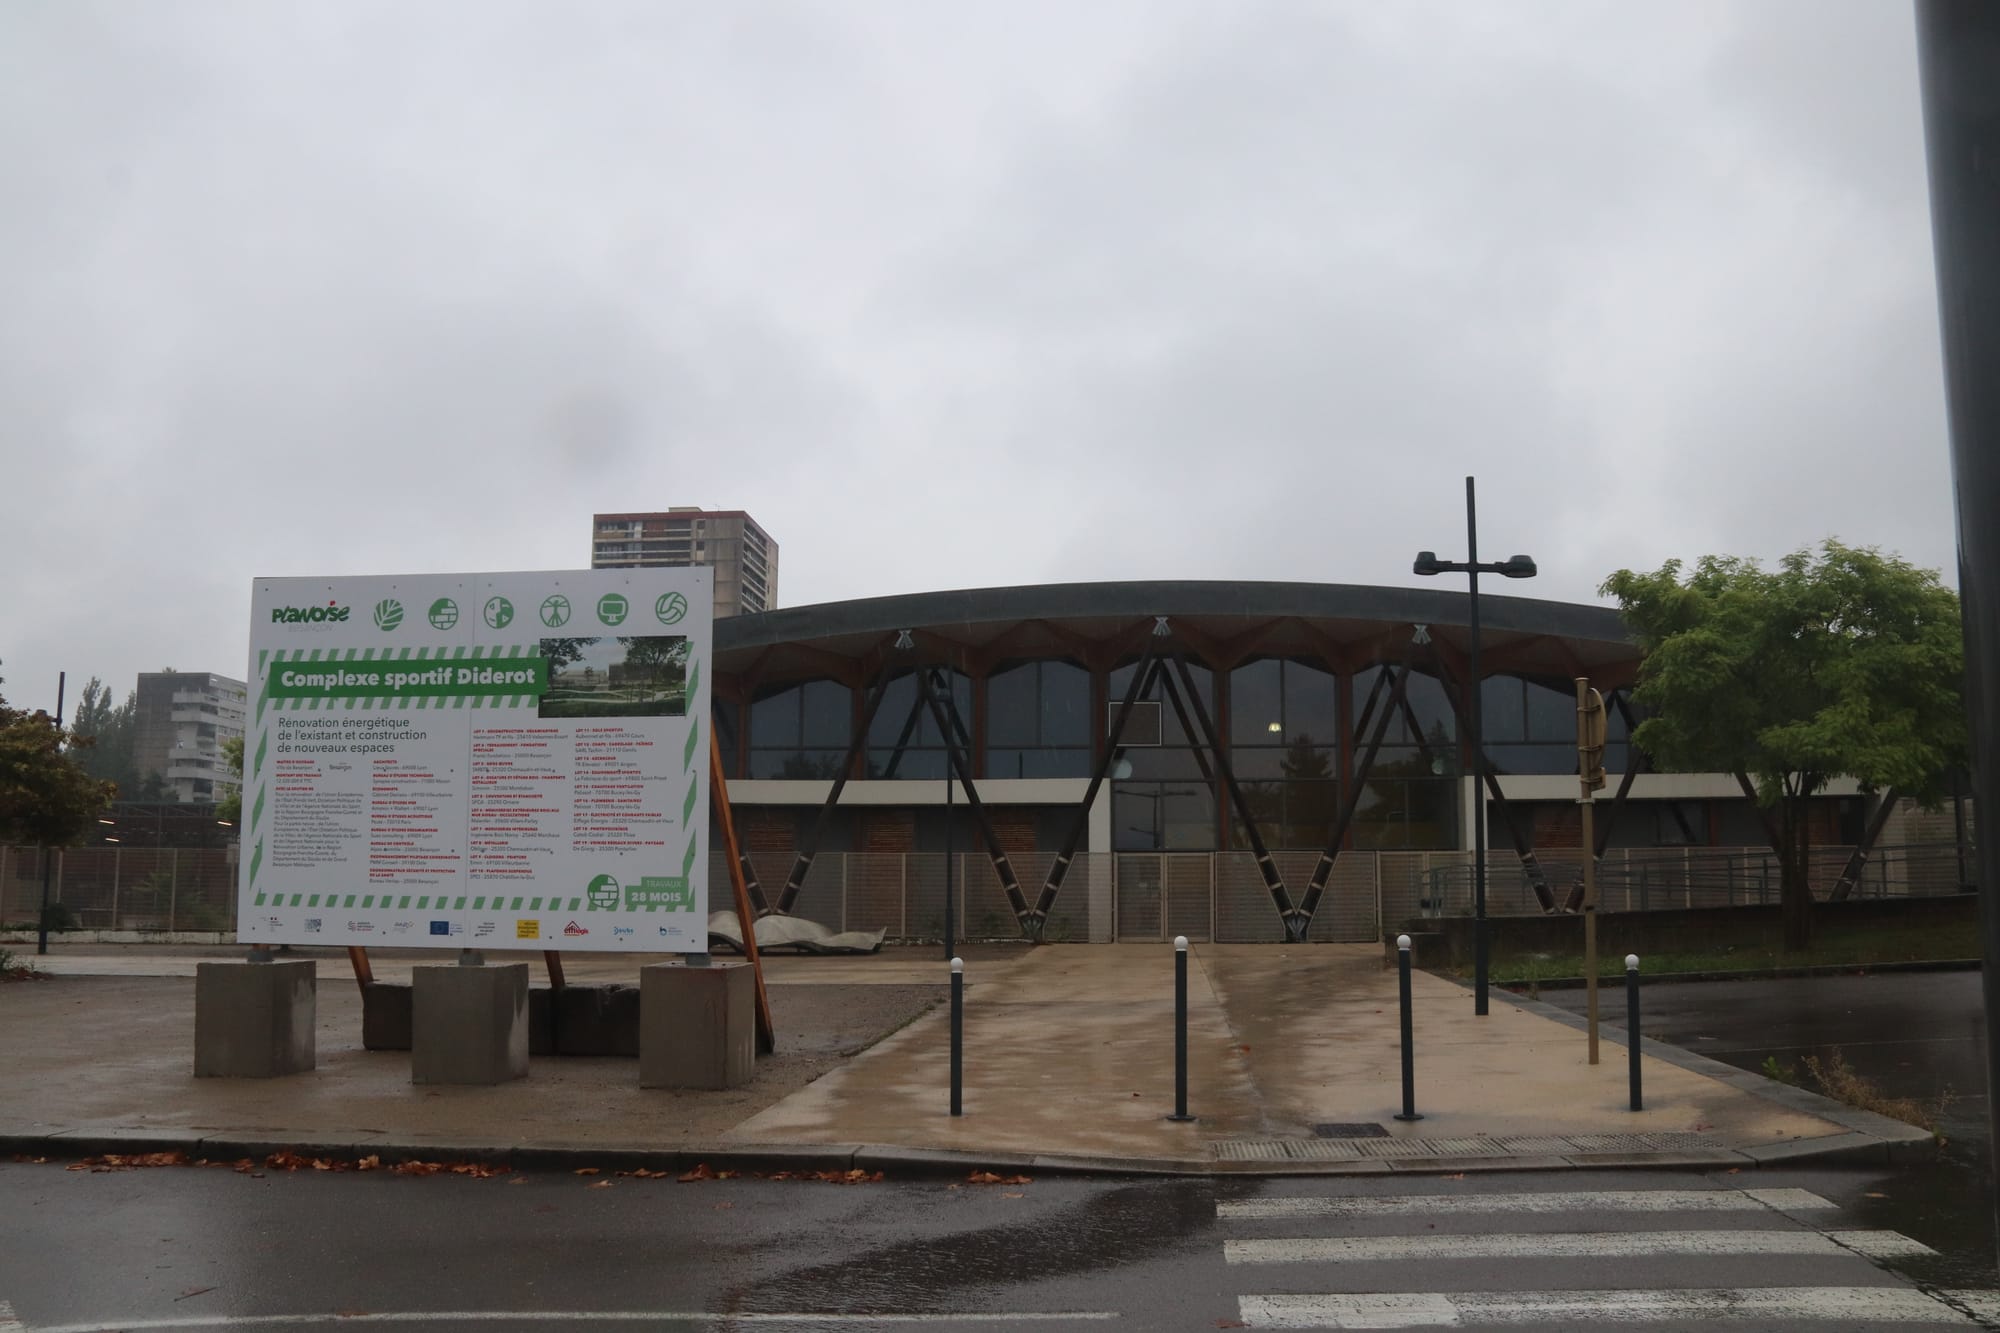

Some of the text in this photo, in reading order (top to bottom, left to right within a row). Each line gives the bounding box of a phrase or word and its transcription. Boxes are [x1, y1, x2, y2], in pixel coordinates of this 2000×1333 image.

[281, 667, 535, 691] Complexe sportif Diderot
[278, 716, 410, 730] Rénovation énergétique
[278, 729, 427, 740] de l'existant et construction
[277, 742, 394, 755] de nouveaux espaces
[646, 880, 682, 888] TRAVAUX
[632, 892, 681, 902] 28 MOIS
